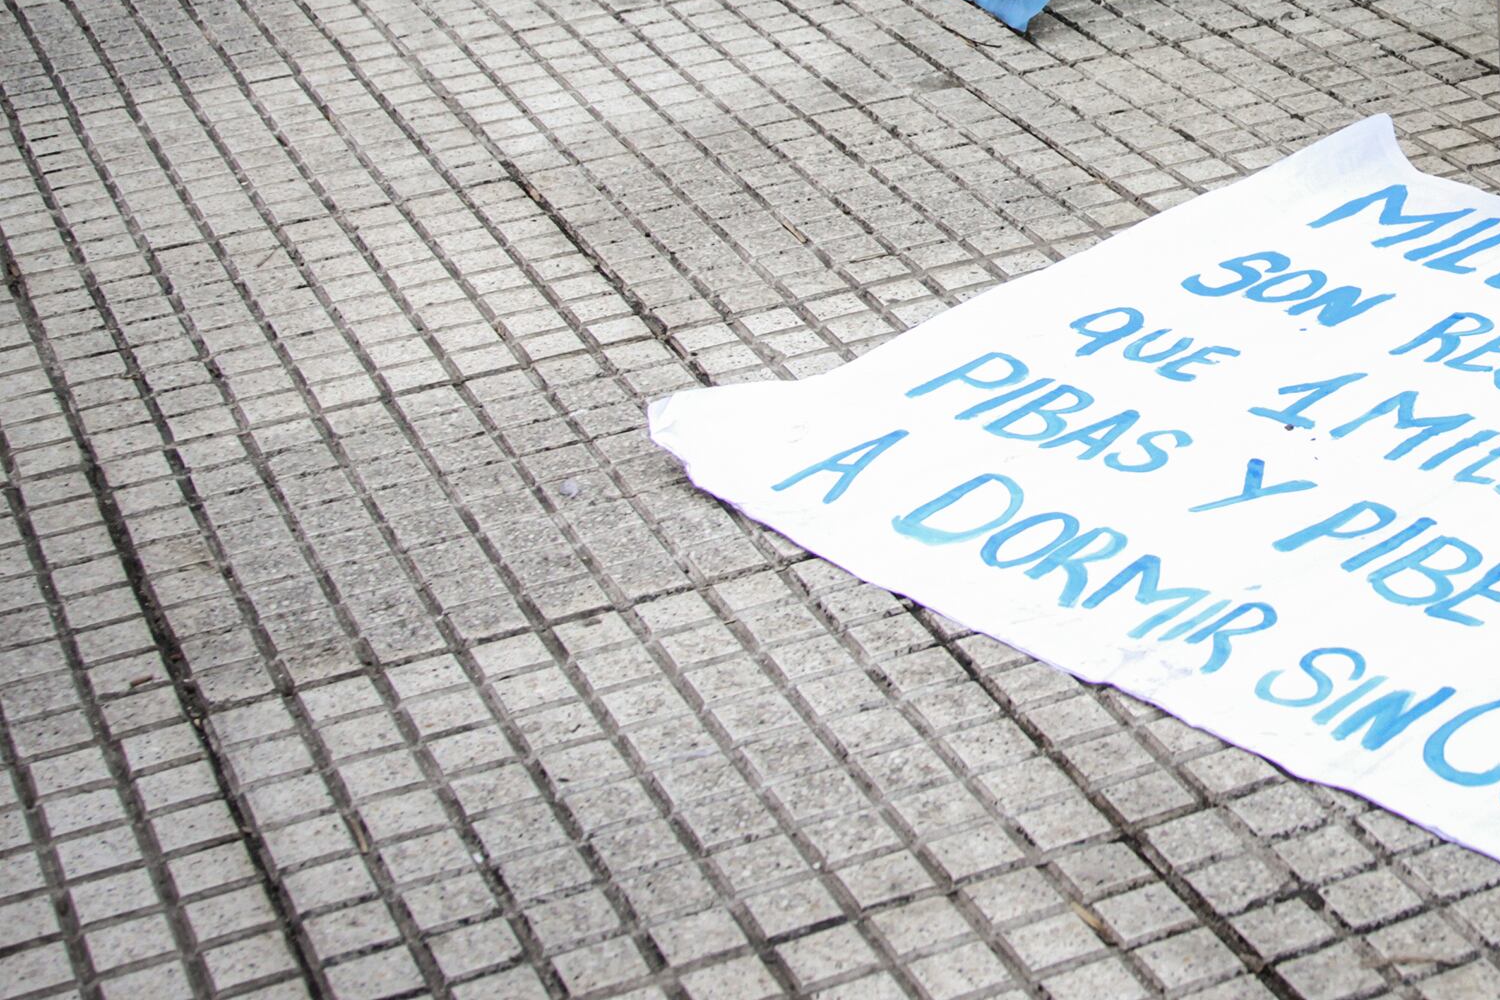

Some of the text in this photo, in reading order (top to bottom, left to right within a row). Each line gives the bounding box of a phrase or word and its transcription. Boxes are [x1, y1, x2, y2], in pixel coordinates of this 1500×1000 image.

[1181, 250, 1396, 327] SON
[906, 352, 1192, 473] PIBAS
[1188, 457, 1317, 513] Y
[1070, 306, 1240, 382] QUE
[1248, 372, 1367, 430] 1
[771, 428, 909, 505] A
[1255, 647, 1456, 751] SIN
